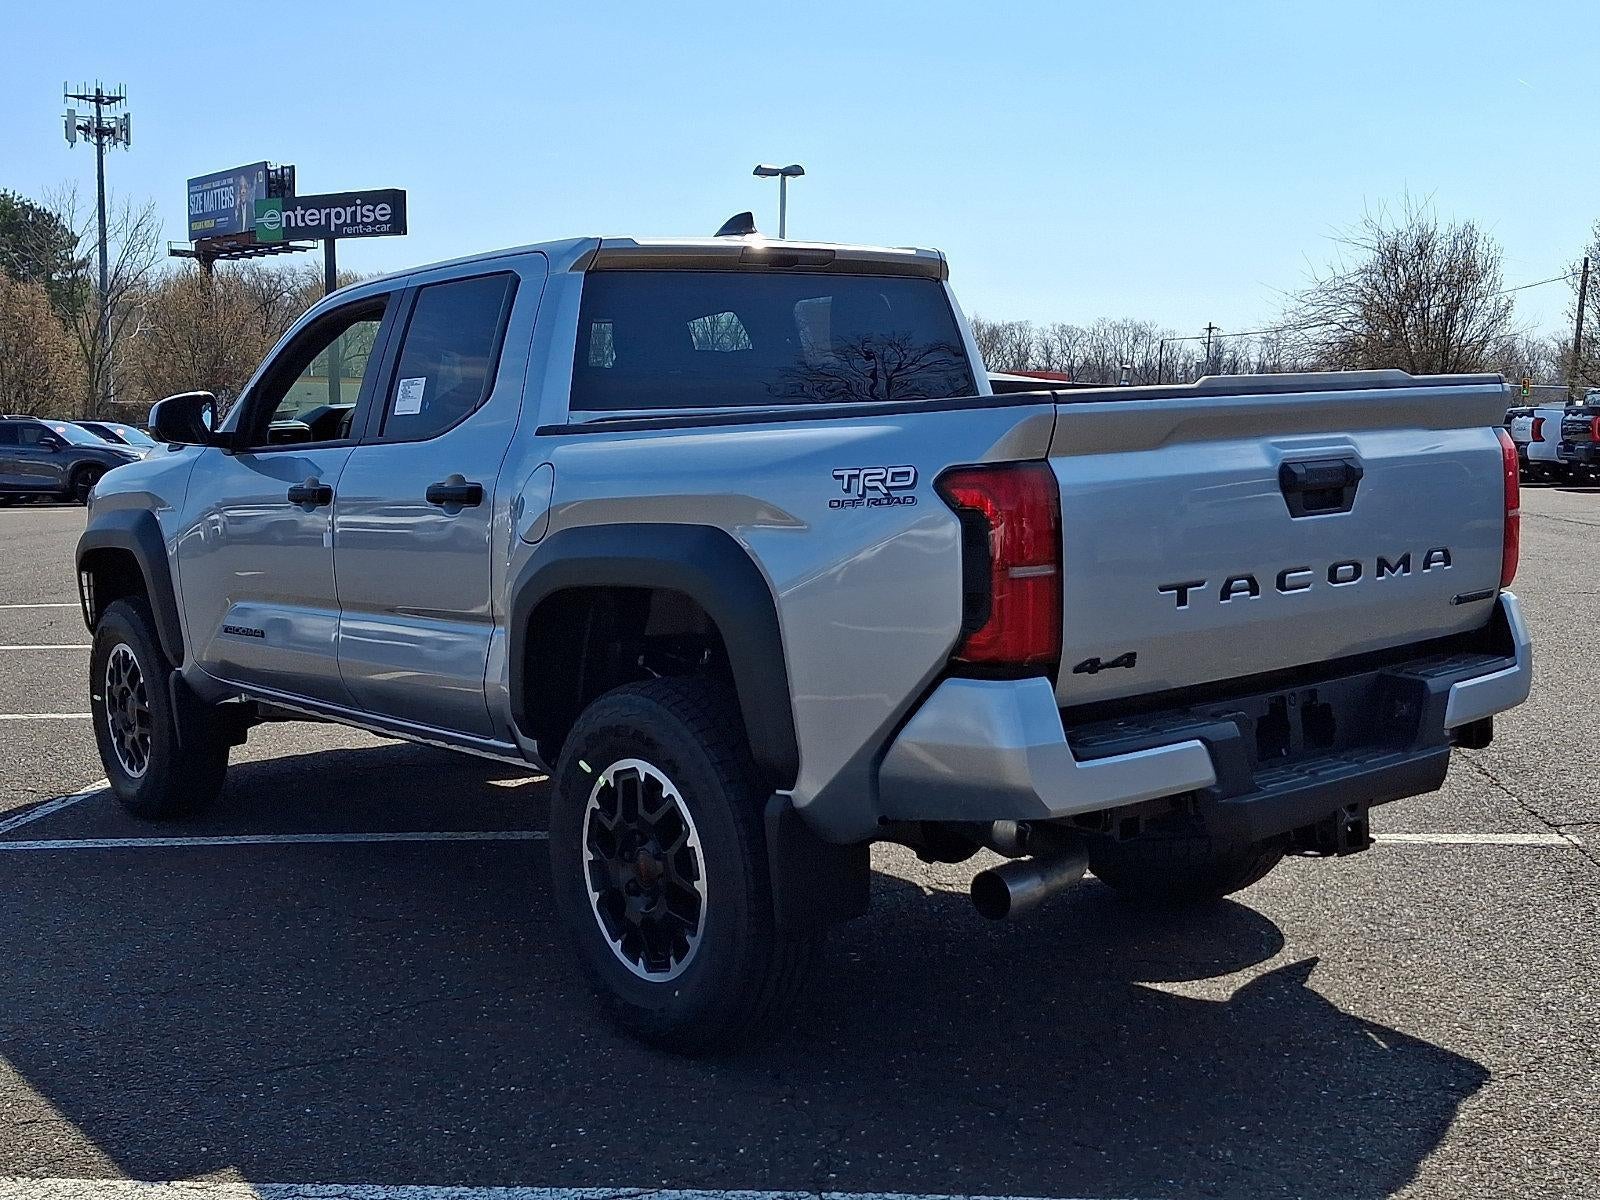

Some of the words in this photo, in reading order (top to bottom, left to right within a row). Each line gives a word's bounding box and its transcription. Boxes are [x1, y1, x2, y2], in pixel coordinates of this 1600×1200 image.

[189, 192, 203, 216] SIZE
[203, 185, 235, 213] MATTERS
[256, 198, 392, 232] enterprise
[342, 223, 392, 235] rent-a-car
[832, 465, 918, 498] TRD
[829, 498, 864, 510] OFF
[866, 495, 918, 508] ROAD
[1156, 546, 1453, 610] TACOMA
[222, 624, 266, 639] TACOMA
